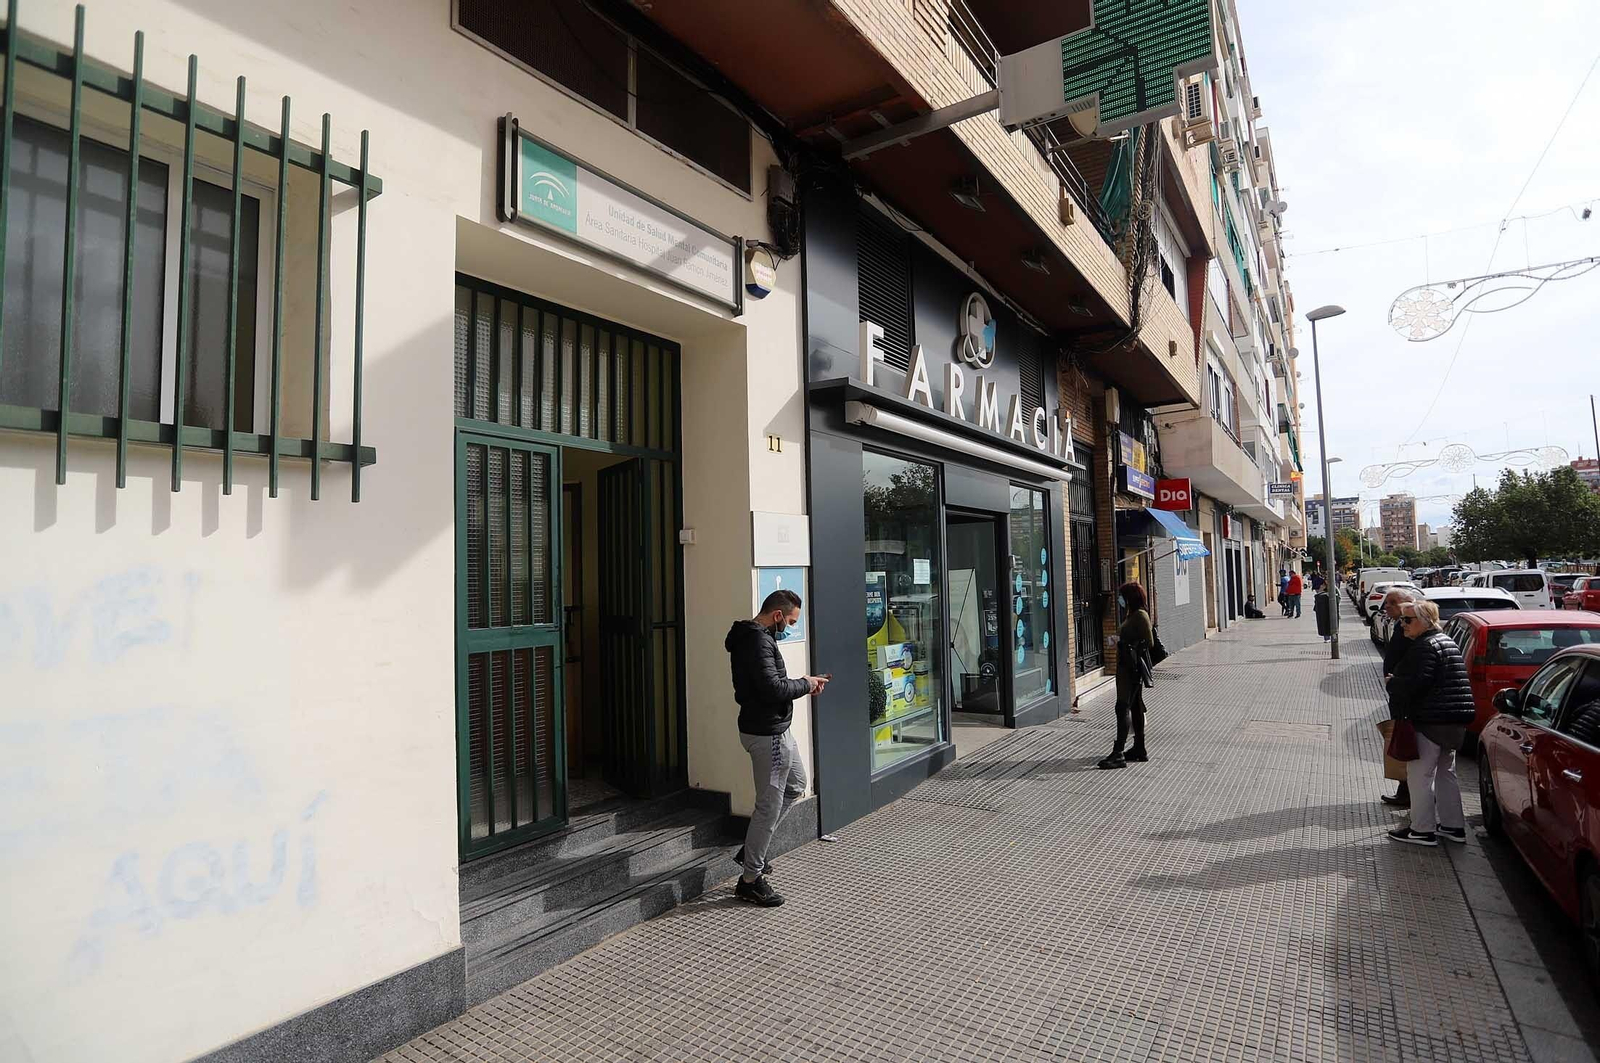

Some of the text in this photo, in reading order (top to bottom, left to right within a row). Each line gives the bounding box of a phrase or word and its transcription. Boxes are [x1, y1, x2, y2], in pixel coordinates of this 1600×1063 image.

[585, 209, 603, 231] Área
[604, 222, 637, 246] Sanitaria
[637, 237, 666, 261] Hospital
[666, 250, 682, 266] Juan
[608, 204, 728, 272] Unidad de Salud Mental Comunitaria
[860, 320, 1076, 463] FARMACIA
[768, 435, 782, 452] 11
